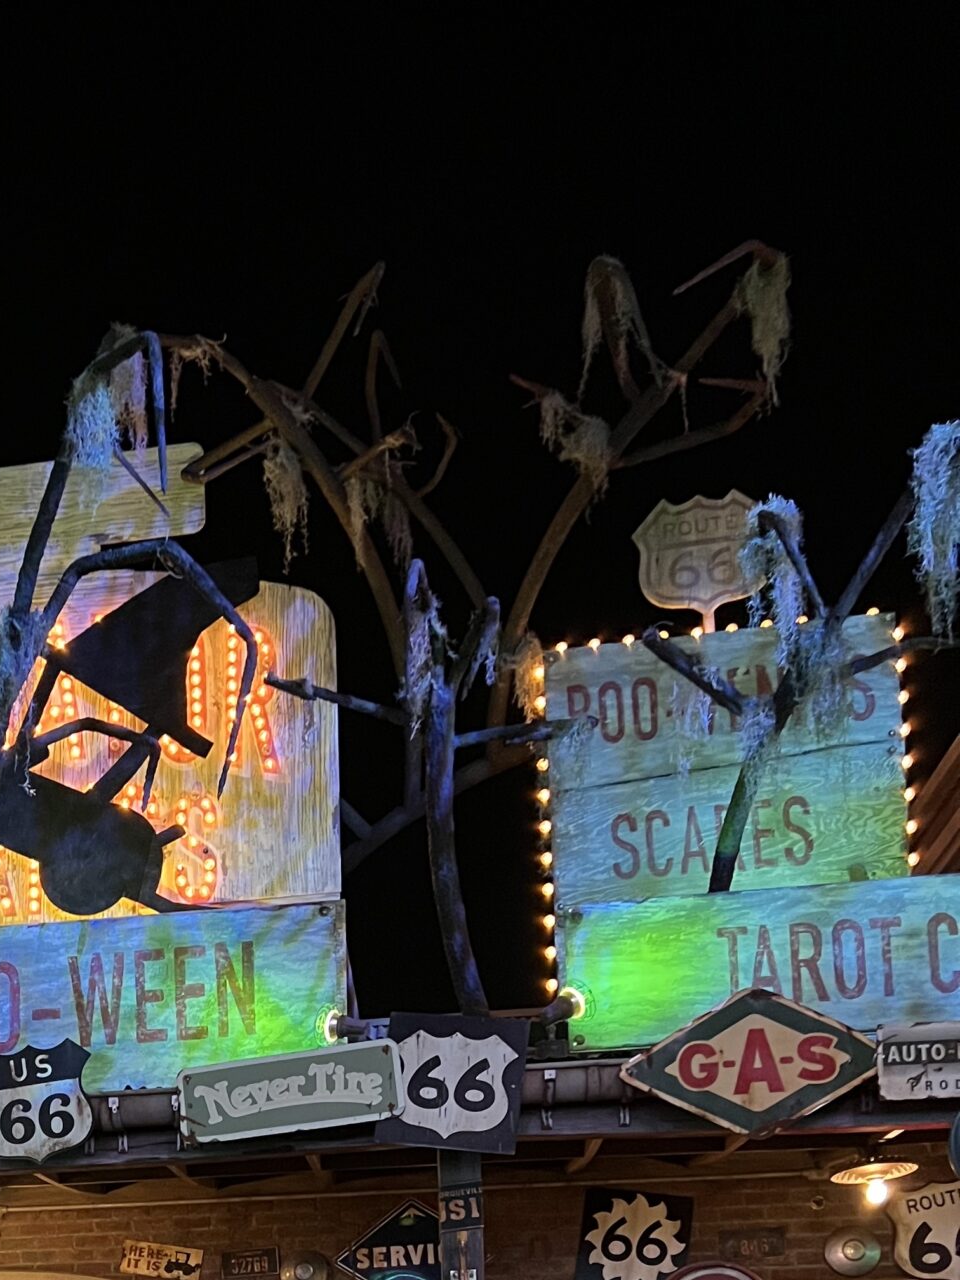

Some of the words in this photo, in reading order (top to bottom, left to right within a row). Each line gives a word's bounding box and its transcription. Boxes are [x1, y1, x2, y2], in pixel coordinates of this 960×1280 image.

[662, 513, 738, 538] ROUTE
[669, 548, 737, 589] 66
[610, 795, 815, 880] SCAES
[717, 916, 902, 1003] TAROT
[677, 1028, 841, 1096] G-A-S
[887, 1042, 960, 1064] AUTO-
[194, 1074, 306, 1126] Never
[307, 1062, 383, 1102] Tire
[406, 1054, 496, 1112] 66
[0, 1092, 76, 1145] 66
[906, 1187, 960, 1215] ROUT
[126, 1257, 142, 1270] IT
[145, 1257, 161, 1272] IS
[127, 1243, 165, 1260] HERE
[356, 1242, 441, 1270] SERVI
[601, 1216, 668, 1267] 66
[908, 1221, 960, 1274] 6
[230, 1256, 269, 1274] 32769
